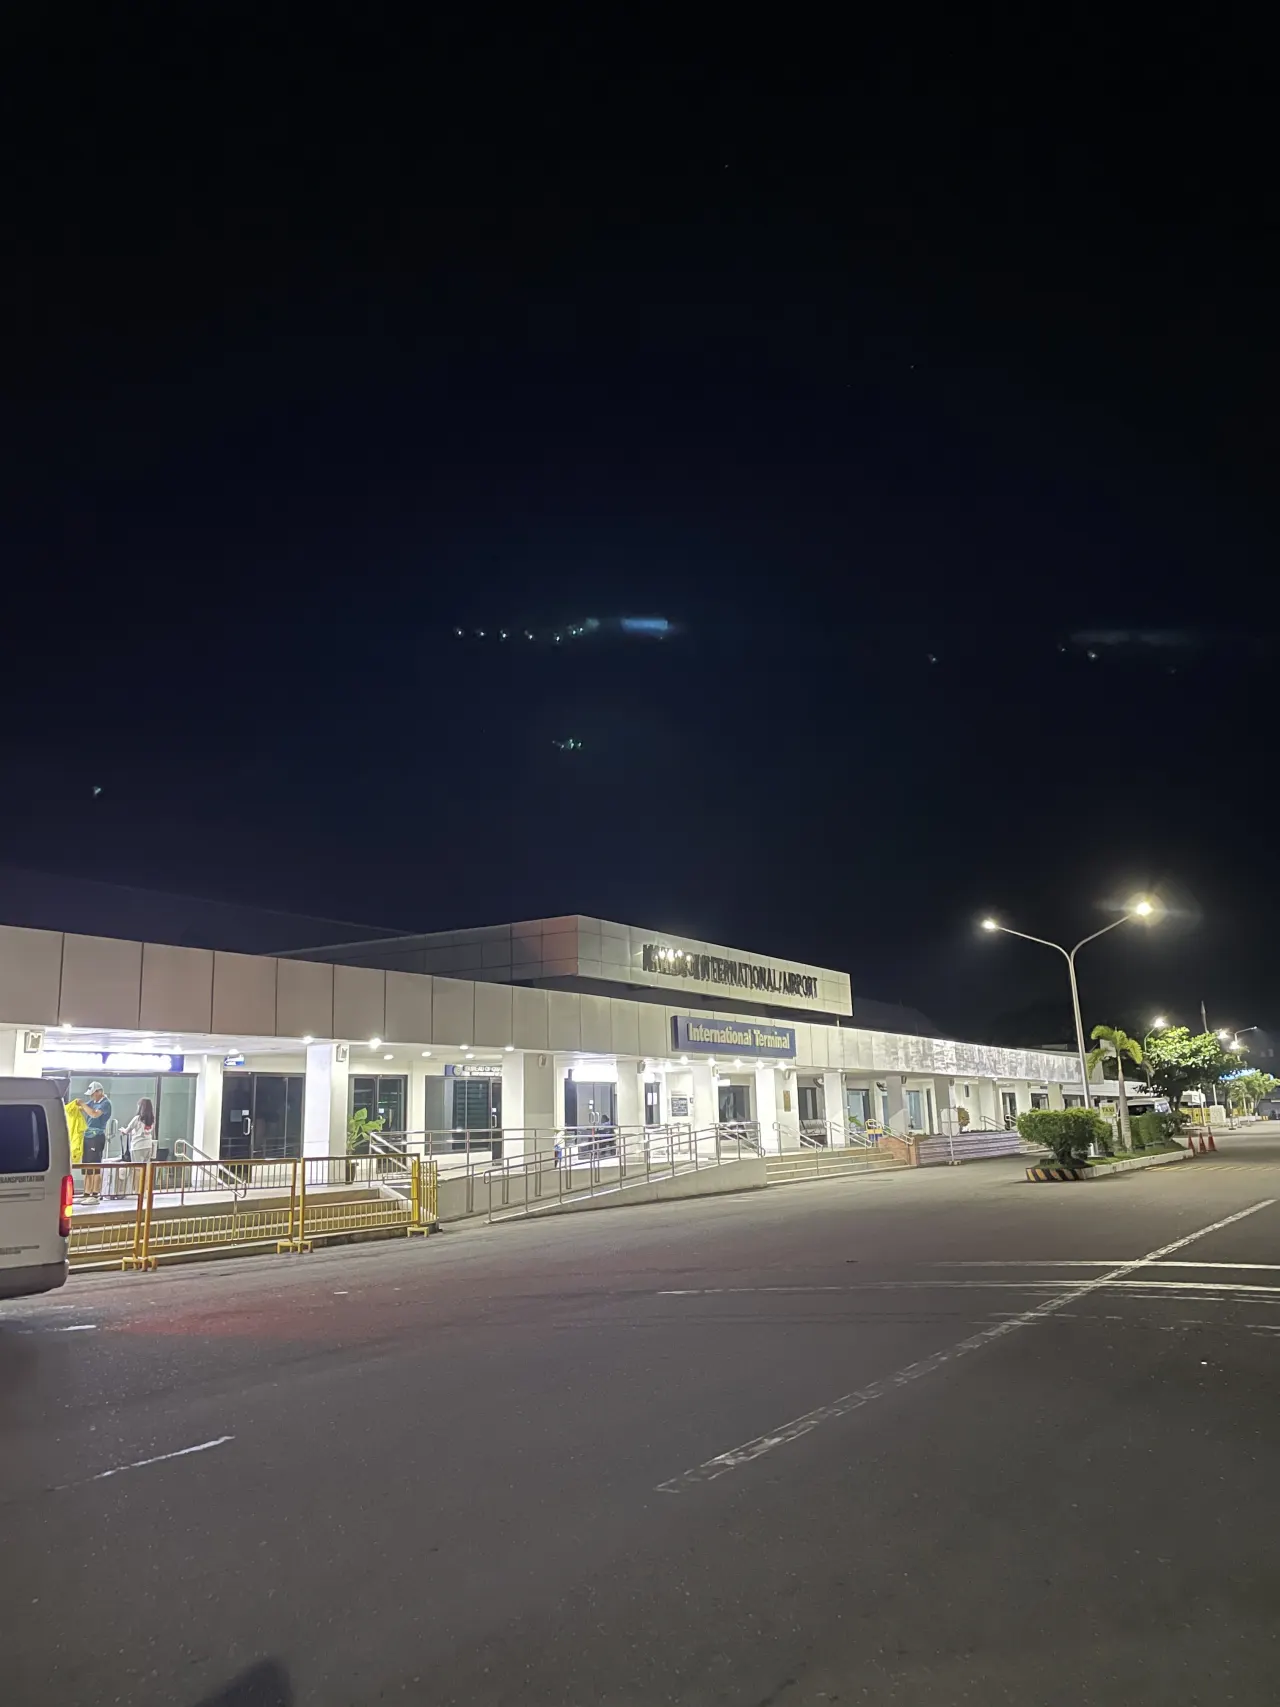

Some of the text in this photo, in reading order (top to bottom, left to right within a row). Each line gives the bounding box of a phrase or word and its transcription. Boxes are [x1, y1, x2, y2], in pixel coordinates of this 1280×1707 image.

[694, 954, 780, 993] INTERNATIONAL
[782, 972, 818, 999] AIRPORT
[688, 1022, 790, 1049] International Terminal
